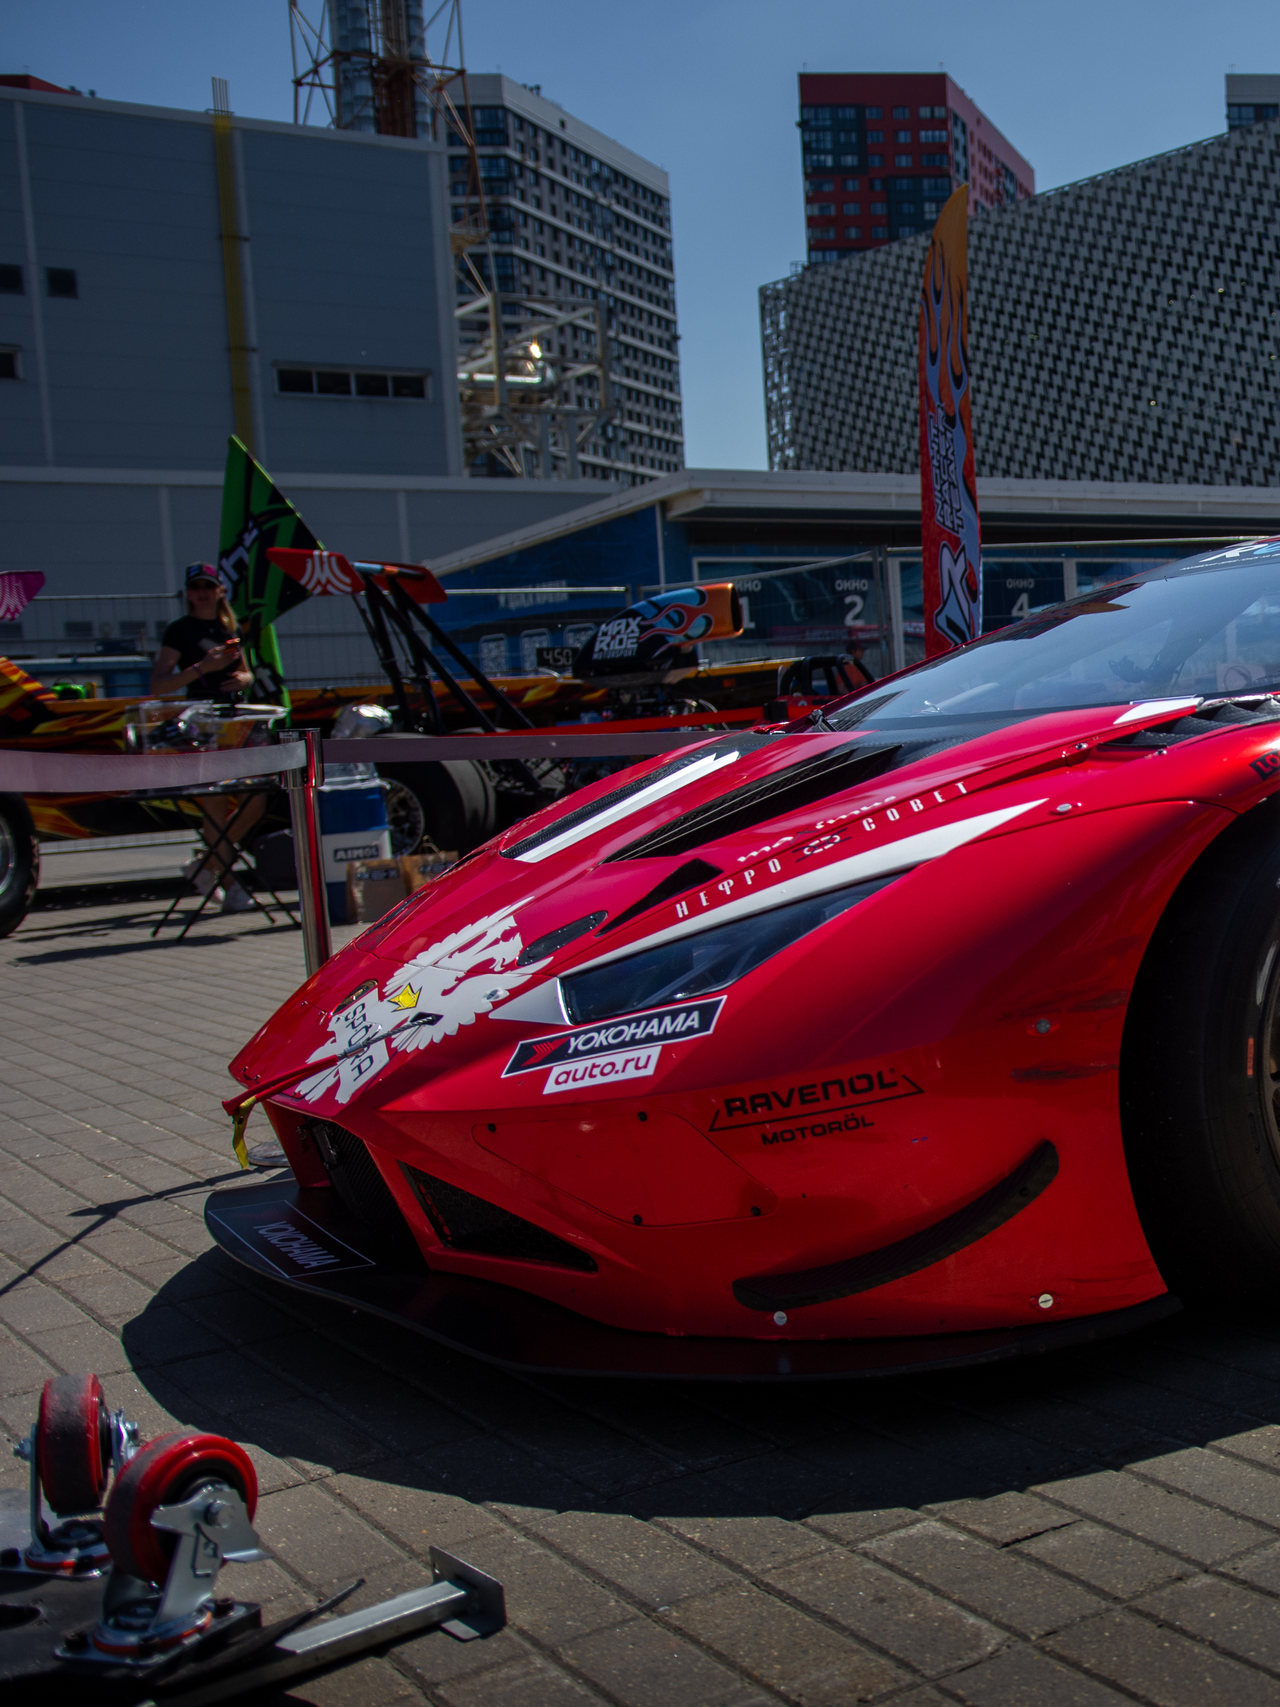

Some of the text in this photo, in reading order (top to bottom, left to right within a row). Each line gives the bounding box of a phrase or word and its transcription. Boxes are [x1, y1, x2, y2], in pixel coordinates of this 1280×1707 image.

[929, 412, 944, 523] NIGHT
[937, 403, 954, 529] RACER
[946, 430, 964, 532] TEAM
[734, 578, 762, 592] КНО
[835, 578, 868, 592] ОКНО
[1006, 577, 1035, 590] ОКНО
[844, 595, 865, 627] 2
[1011, 592, 1030, 619] 4
[598, 616, 642, 637] MAX
[675, 781, 969, 918] НЕФРО СОВЕТ
[568, 1010, 700, 1054] YOKOHAMA
[555, 1055, 651, 1085] auto.ru
[724, 1070, 898, 1117] RAVENOL
[761, 1113, 875, 1146] MOTORÖL
[253, 1220, 341, 1269] YOKOHAMA
